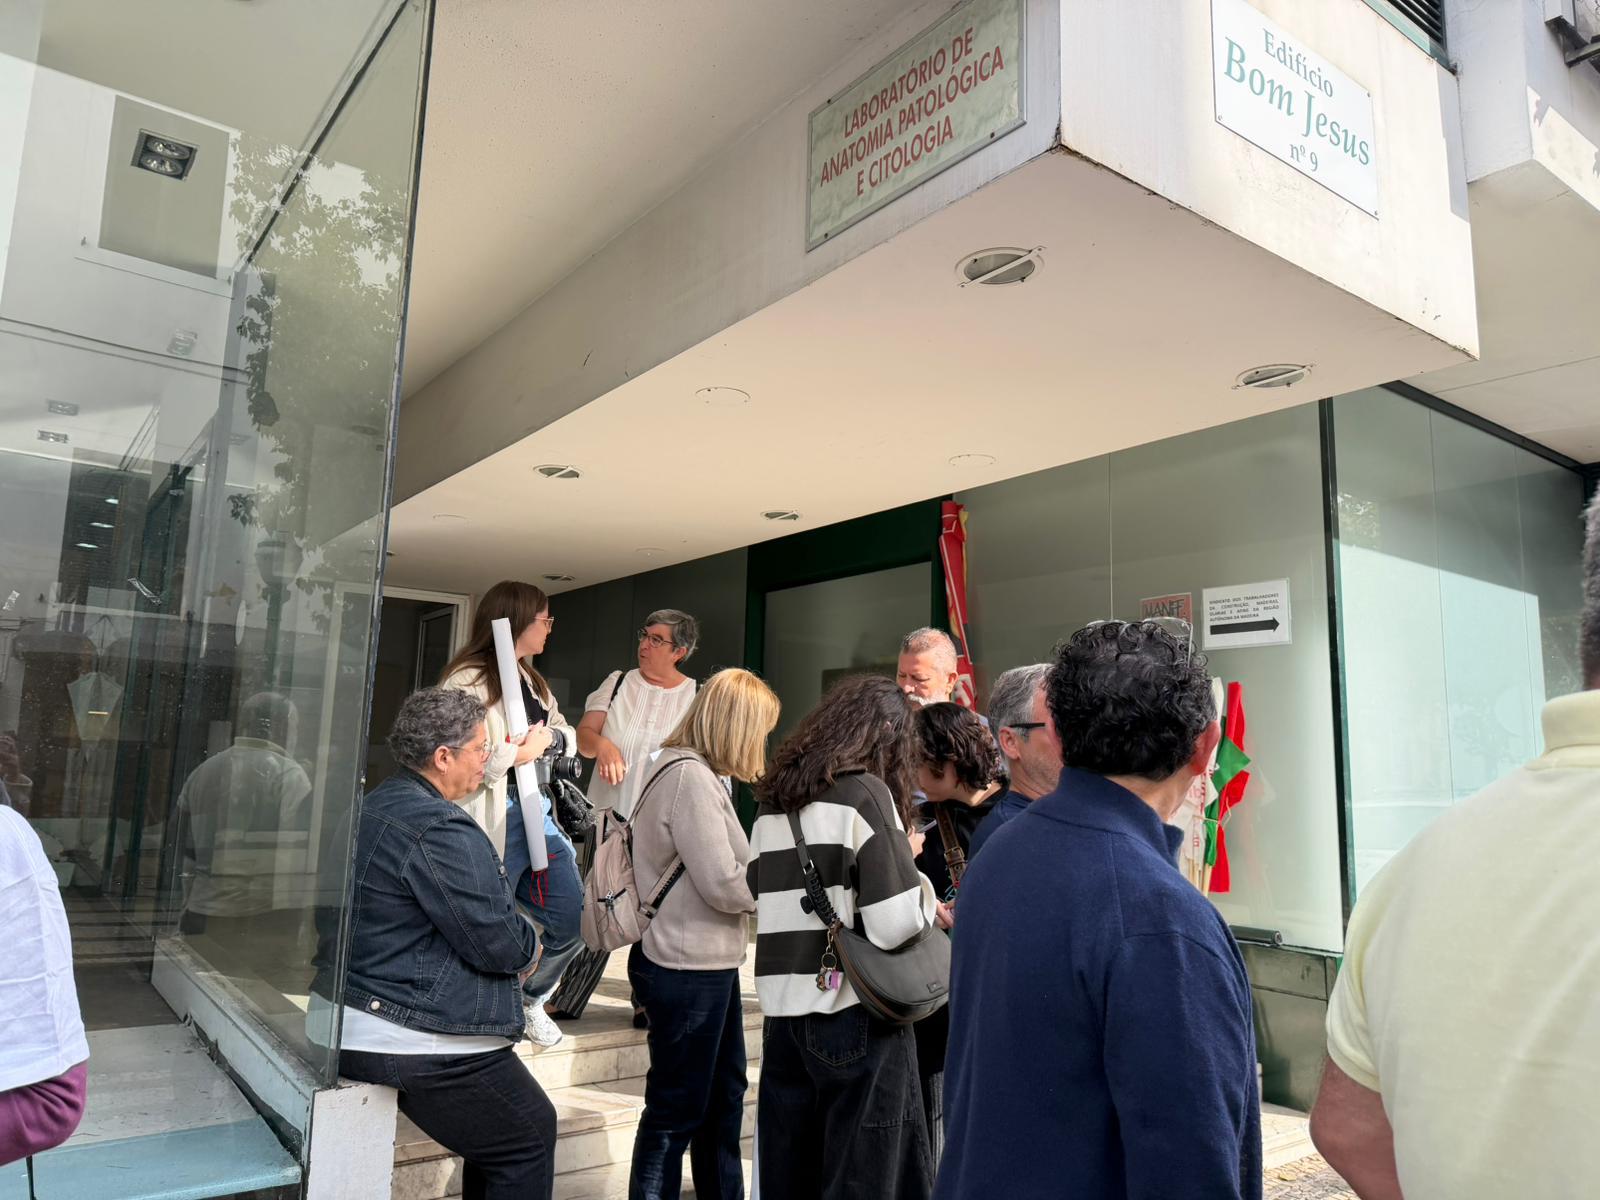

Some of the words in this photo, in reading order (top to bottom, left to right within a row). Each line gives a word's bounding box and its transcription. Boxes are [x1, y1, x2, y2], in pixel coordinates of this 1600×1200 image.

[843, 48, 946, 139] LABORATÓRIO
[951, 27, 973, 66] DE
[1223, 36, 1295, 117] Bom
[1302, 90, 1370, 166] Jesus
[1262, 28, 1333, 98] Edifício
[820, 118, 894, 188] ANATOMIA
[898, 46, 1004, 135] PATOLÓGICA
[857, 169, 864, 197] E
[868, 115, 953, 188] CITOLOGIA
[1289, 143, 1306, 163] nº
[1310, 151, 1318, 172] 9
